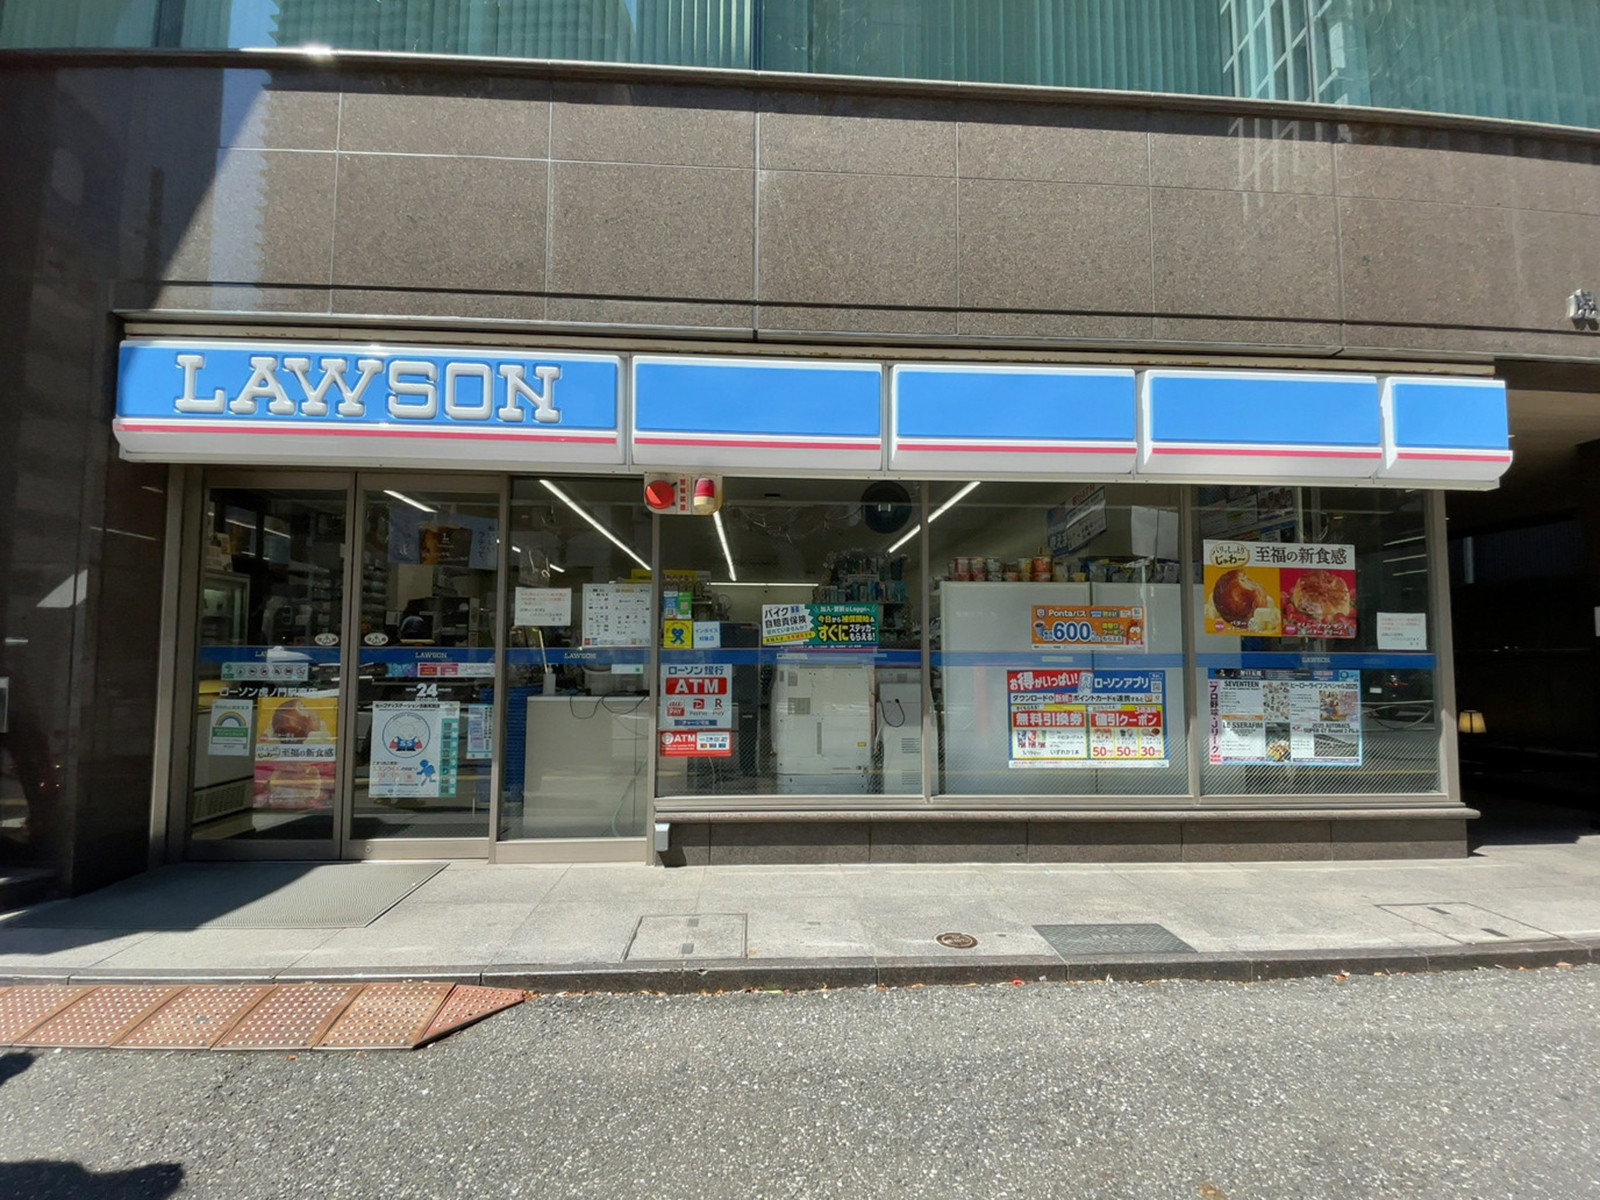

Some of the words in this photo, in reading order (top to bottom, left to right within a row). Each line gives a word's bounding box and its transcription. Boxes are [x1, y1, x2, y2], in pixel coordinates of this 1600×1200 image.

[174, 353, 562, 424] LAWSON
[1255, 545, 1348, 565] 至福の新食感
[764, 607, 789, 619] バイク
[1048, 609, 1087, 618] Pontaパス
[765, 615, 807, 628] 自賠責保険
[818, 624, 849, 642] すぐに
[1053, 622, 1091, 640] 600
[668, 665, 724, 676] ローソン銀行
[674, 678, 719, 694] ATM
[1009, 671, 1079, 691] お得がいっぱい!
[1094, 677, 1149, 689] ローソンアプリ
[416, 683, 438, 697] 24
[1016, 712, 1082, 726] 無料引換券
[1095, 712, 1157, 727] 値引クーポン
[674, 734, 696, 743] ATM
[1093, 746, 1107, 757] 50
[1116, 746, 1130, 757] 50
[1140, 746, 1155, 757] 30
